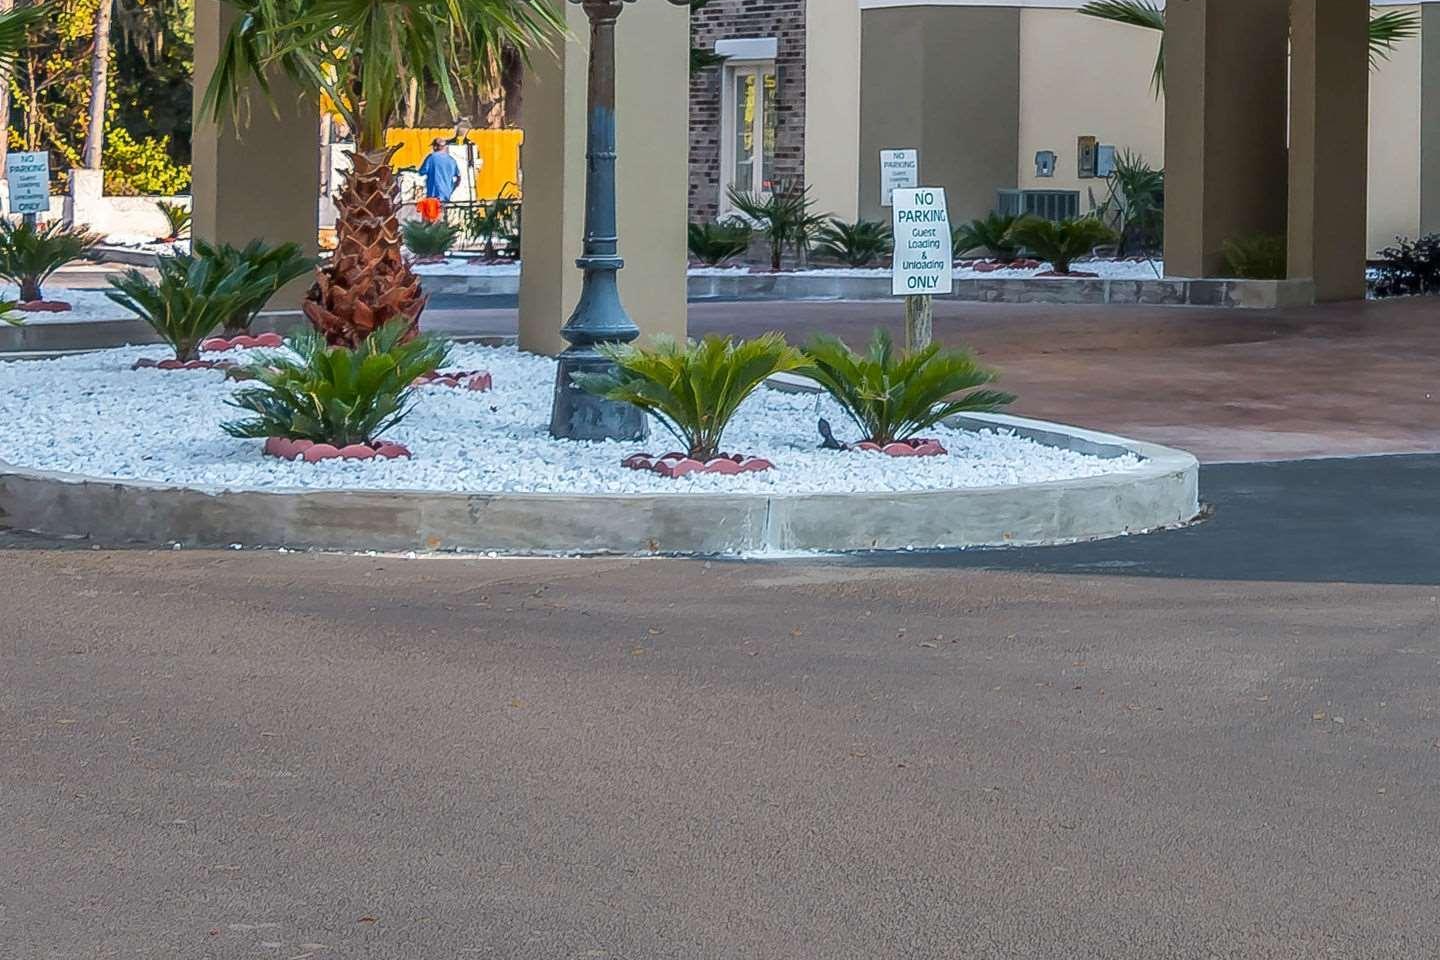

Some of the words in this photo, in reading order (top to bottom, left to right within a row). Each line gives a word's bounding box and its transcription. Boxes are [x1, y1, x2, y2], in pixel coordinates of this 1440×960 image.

[893, 152, 905, 160] NO
[914, 192, 934, 206] NO
[898, 209, 946, 223] PARKING
[912, 228, 936, 237] Guest
[908, 239, 940, 249] Loading
[921, 251, 927, 260] &
[902, 260, 944, 270] Unloading
[907, 275, 939, 289] ONLY
